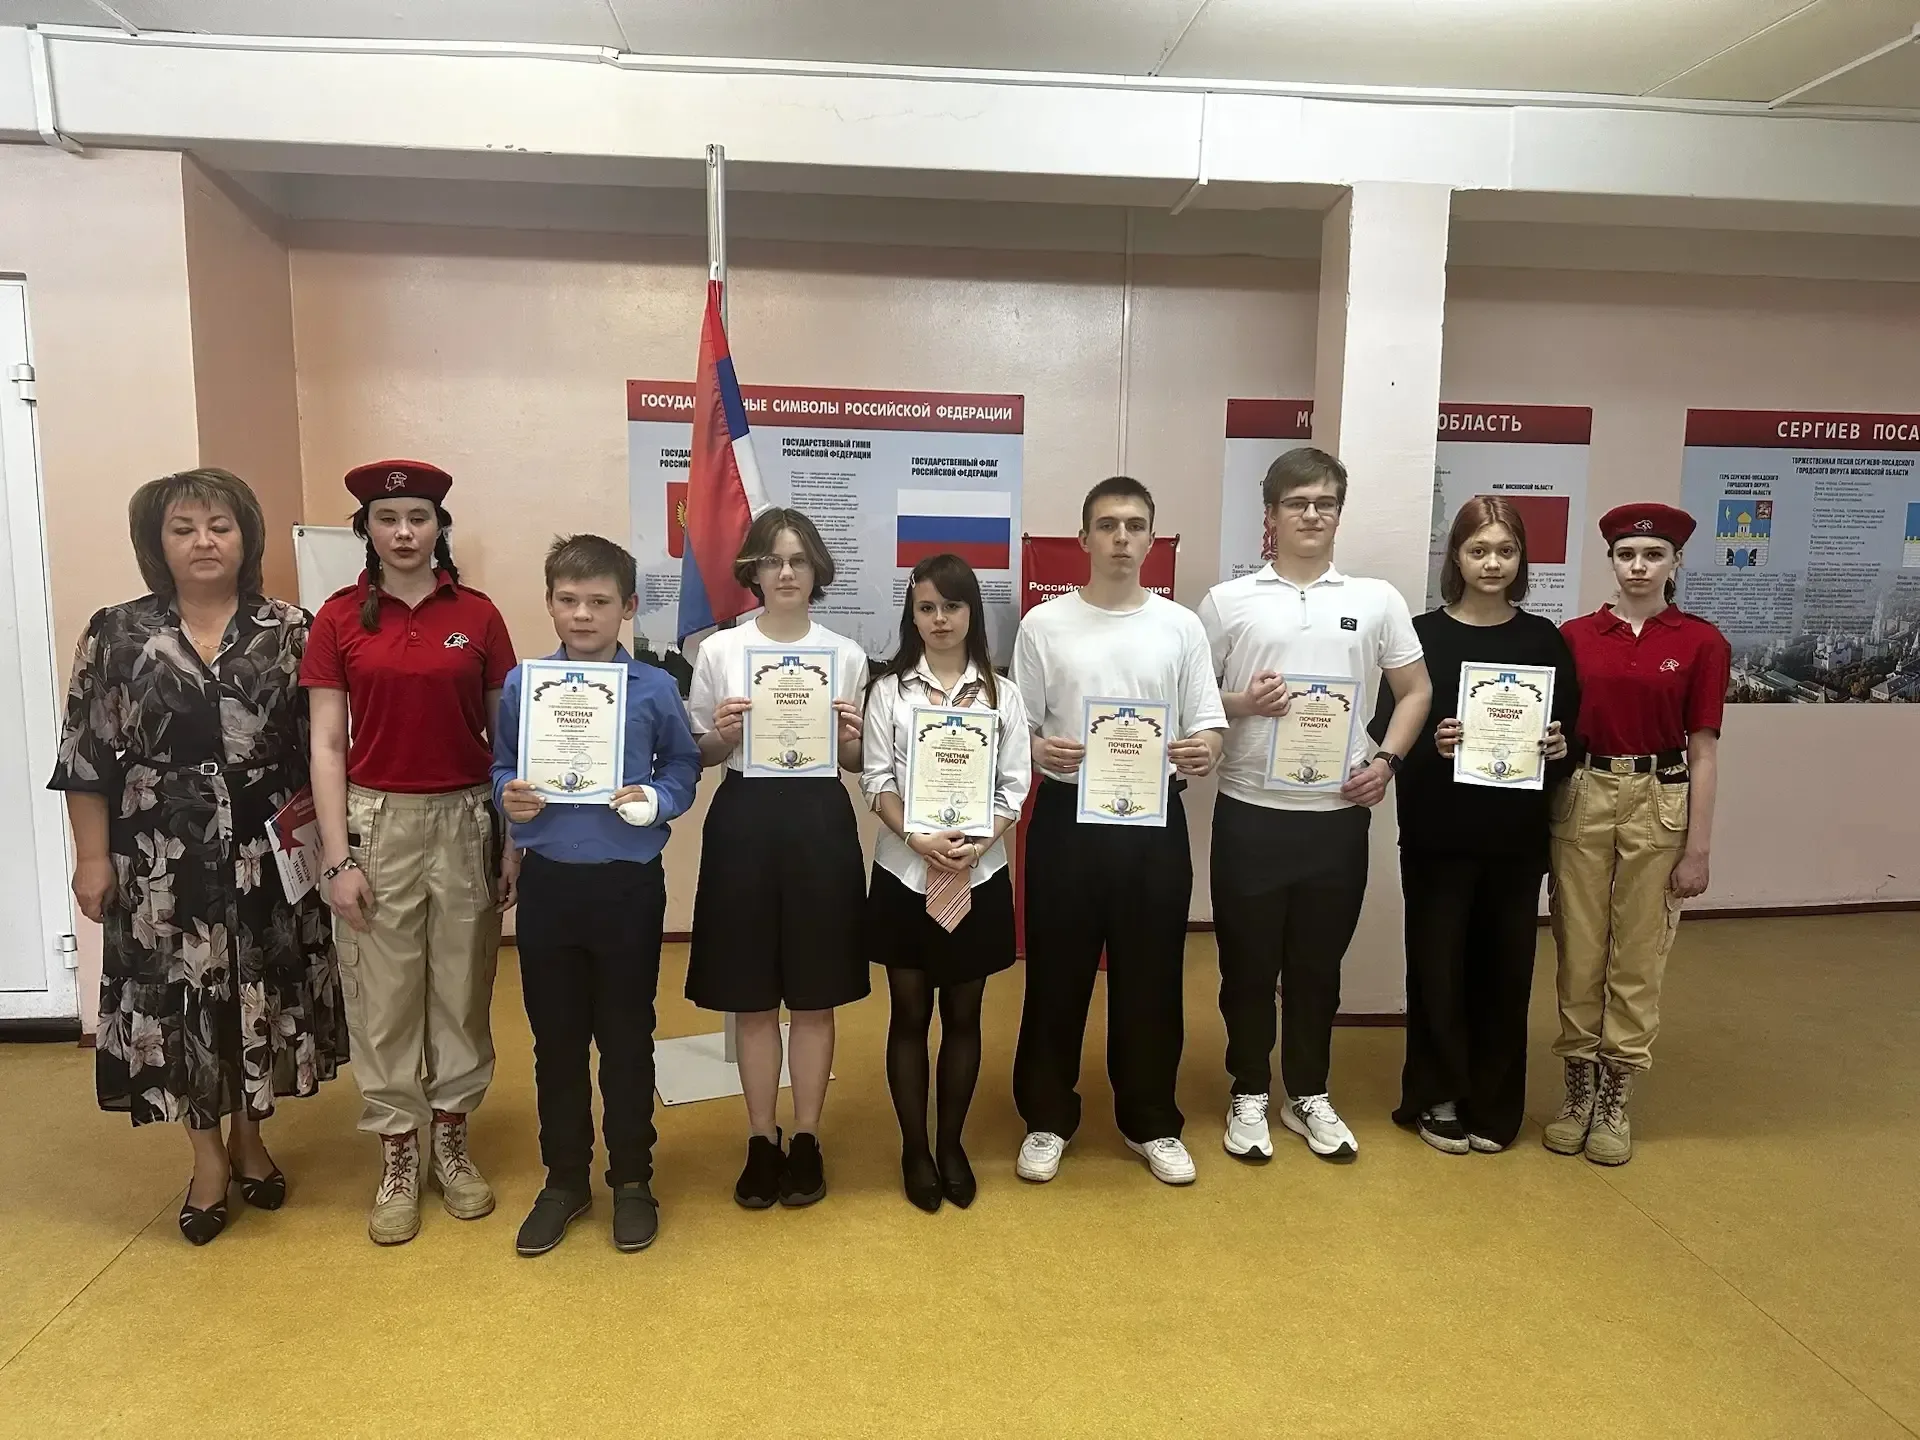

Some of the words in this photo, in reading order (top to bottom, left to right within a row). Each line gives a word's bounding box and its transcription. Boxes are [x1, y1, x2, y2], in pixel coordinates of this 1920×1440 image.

[773, 399, 839, 415] СИМВОЛЫ
[844, 401, 931, 418] РОССИЙСКОЙ
[936, 405, 1013, 422] ФЕДЕРАЦИИ
[1437, 412, 1523, 433] ОБЛАСТЬ
[1777, 420, 1861, 440] СЕРГИЕВ
[1872, 423, 1920, 441] ПОСА
[782, 437, 851, 448] ГОСУДАРСТВЕННЫЙ
[852, 439, 871, 449] ГИМН
[782, 448, 829, 458] РОССИЙСКОЙ
[829, 450, 872, 460] ФЕДЕРАЦИИ
[911, 457, 978, 467] ГОСУДАРСТВЕННЫЙ
[978, 459, 998, 467] ФЛАГ
[1792, 457, 1836, 465] ТОРЖЕСТВЕННАЯ
[1836, 458, 1854, 466] ПЕСНЯ
[1854, 458, 1915, 468] СЕРГИЕВО-ПОСАДСКОГО
[911, 467, 956, 477] РОССИЙСКОЙ
[957, 469, 998, 479] ФЕДЕРАЦИИ
[1795, 467, 1829, 475] ГОРОДСКОГО
[1850, 467, 1885, 476] МОСКОВСКОЙ
[1028, 581, 1083, 593] Российс
[554, 710, 593, 718] ПОЧЕТНАЯ
[1108, 741, 1143, 749] ПОЧЕТНАЯ
[935, 751, 970, 759] ПОЧЕТНАЯ
